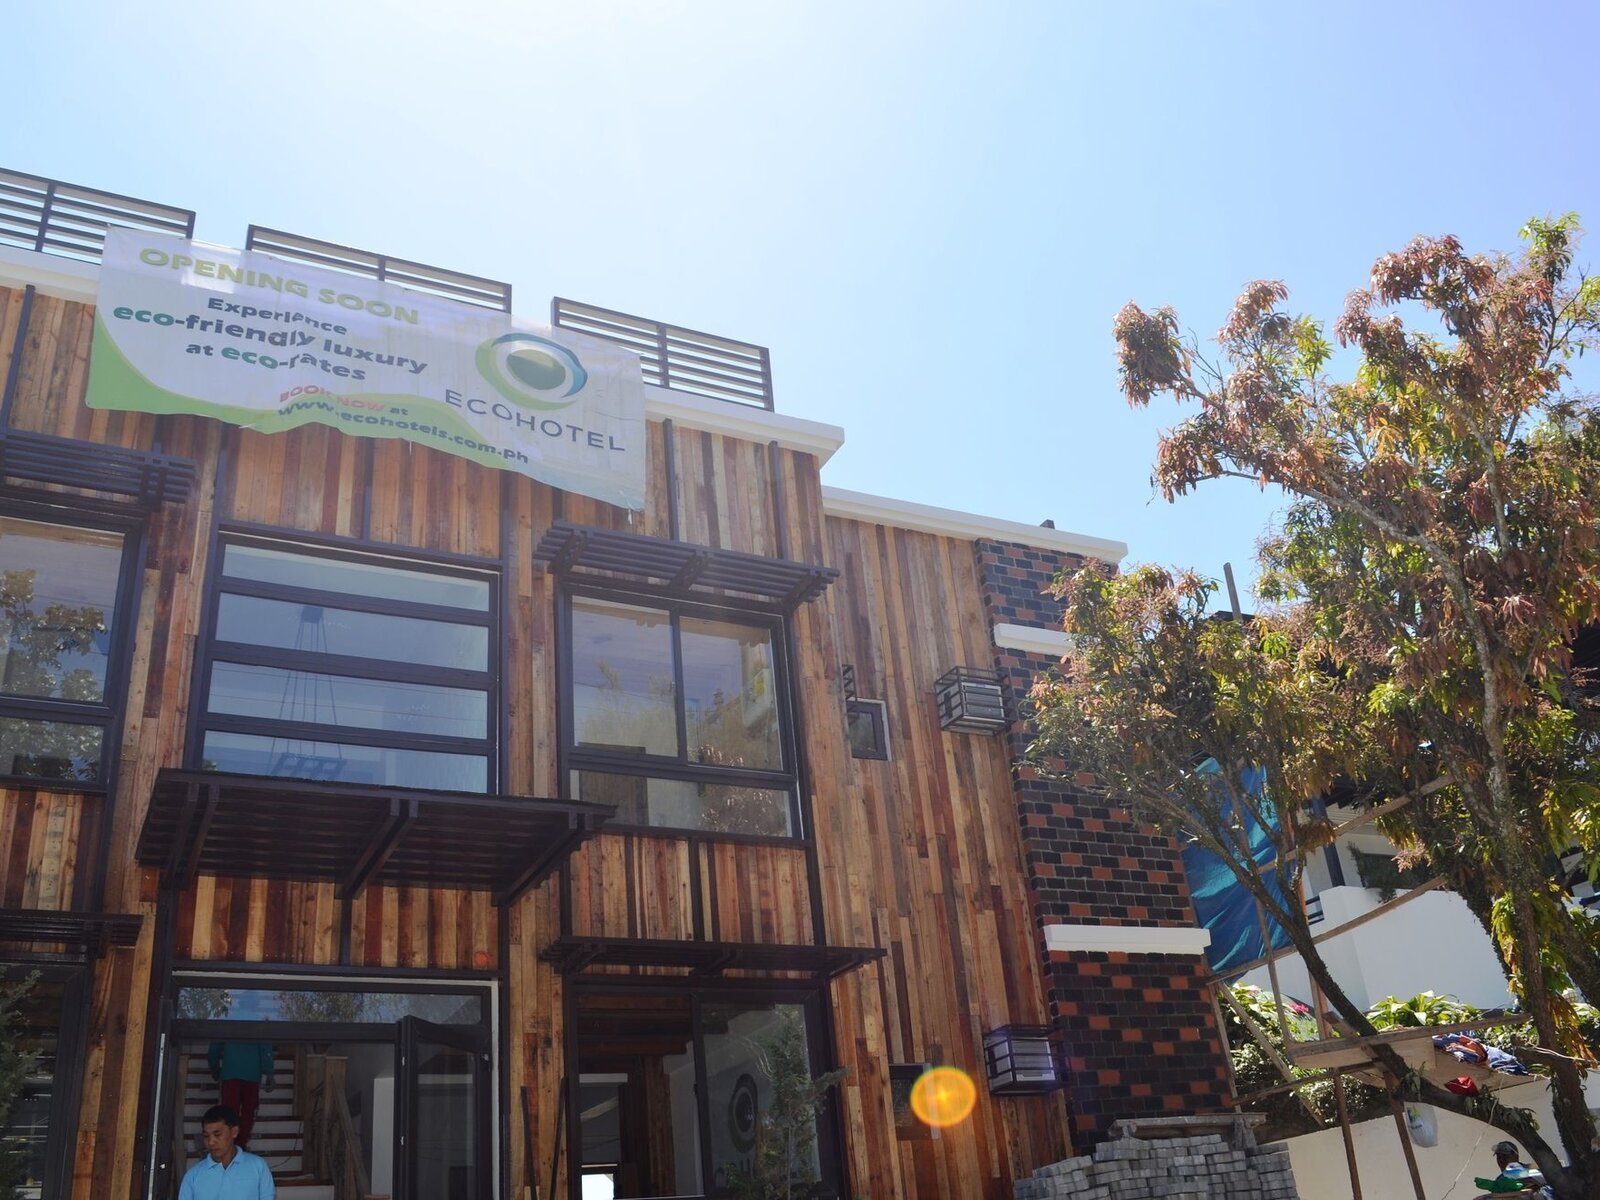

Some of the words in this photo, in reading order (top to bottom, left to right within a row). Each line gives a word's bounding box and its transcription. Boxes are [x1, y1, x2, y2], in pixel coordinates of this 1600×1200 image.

[139, 247, 309, 299] OPENING
[318, 288, 419, 325] SOON
[207, 297, 348, 336] Experience
[113, 306, 316, 347] eco-friendly
[323, 338, 428, 375] luxury
[186, 343, 214, 356] at
[221, 346, 366, 381] eco-rates
[278, 401, 529, 464] www.ecohotels.com.ph
[336, 395, 385, 412] NOW
[390, 407, 409, 416] at
[445, 389, 626, 452] ECOHOTEL
